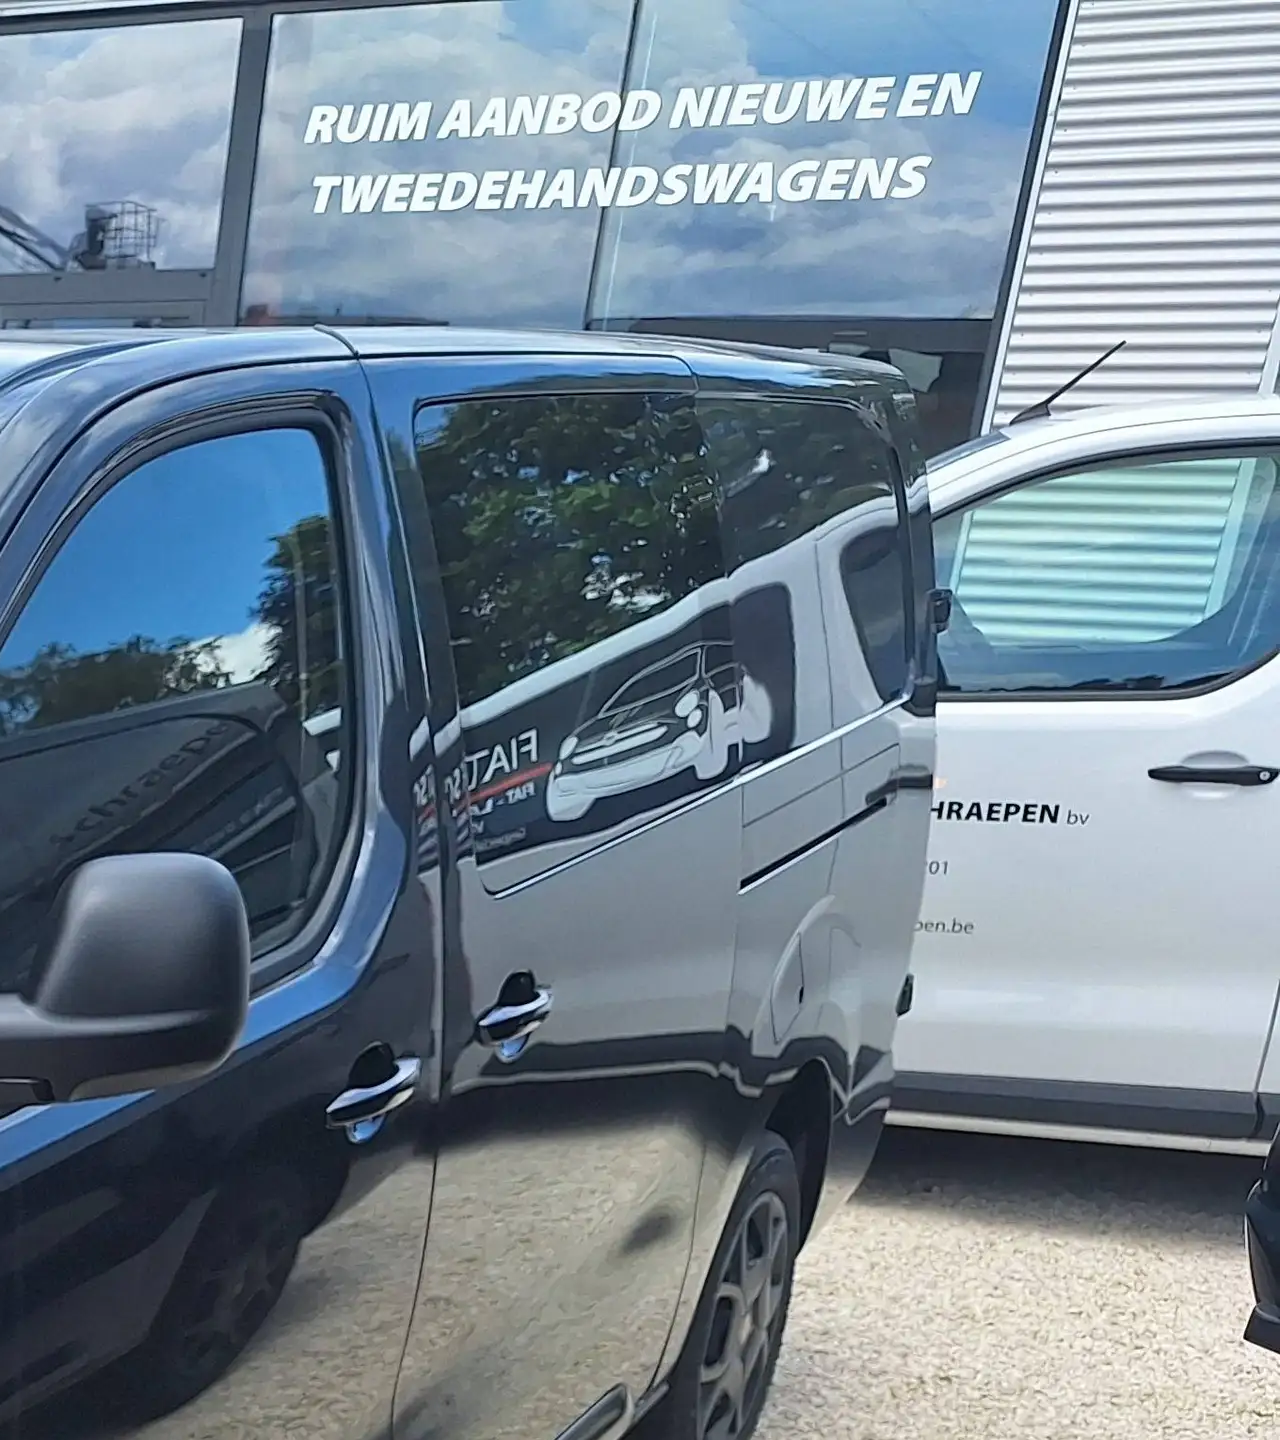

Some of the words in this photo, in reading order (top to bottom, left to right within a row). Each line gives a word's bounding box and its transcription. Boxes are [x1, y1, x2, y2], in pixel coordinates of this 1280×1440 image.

[303, 101, 433, 144] RUIM
[436, 89, 662, 139] AANBOD
[668, 76, 897, 129] NIEUWE
[896, 71, 983, 118] EN
[312, 155, 932, 214] TWEEDEHANDSWAGENS
[1066, 809, 1090, 825] bv
